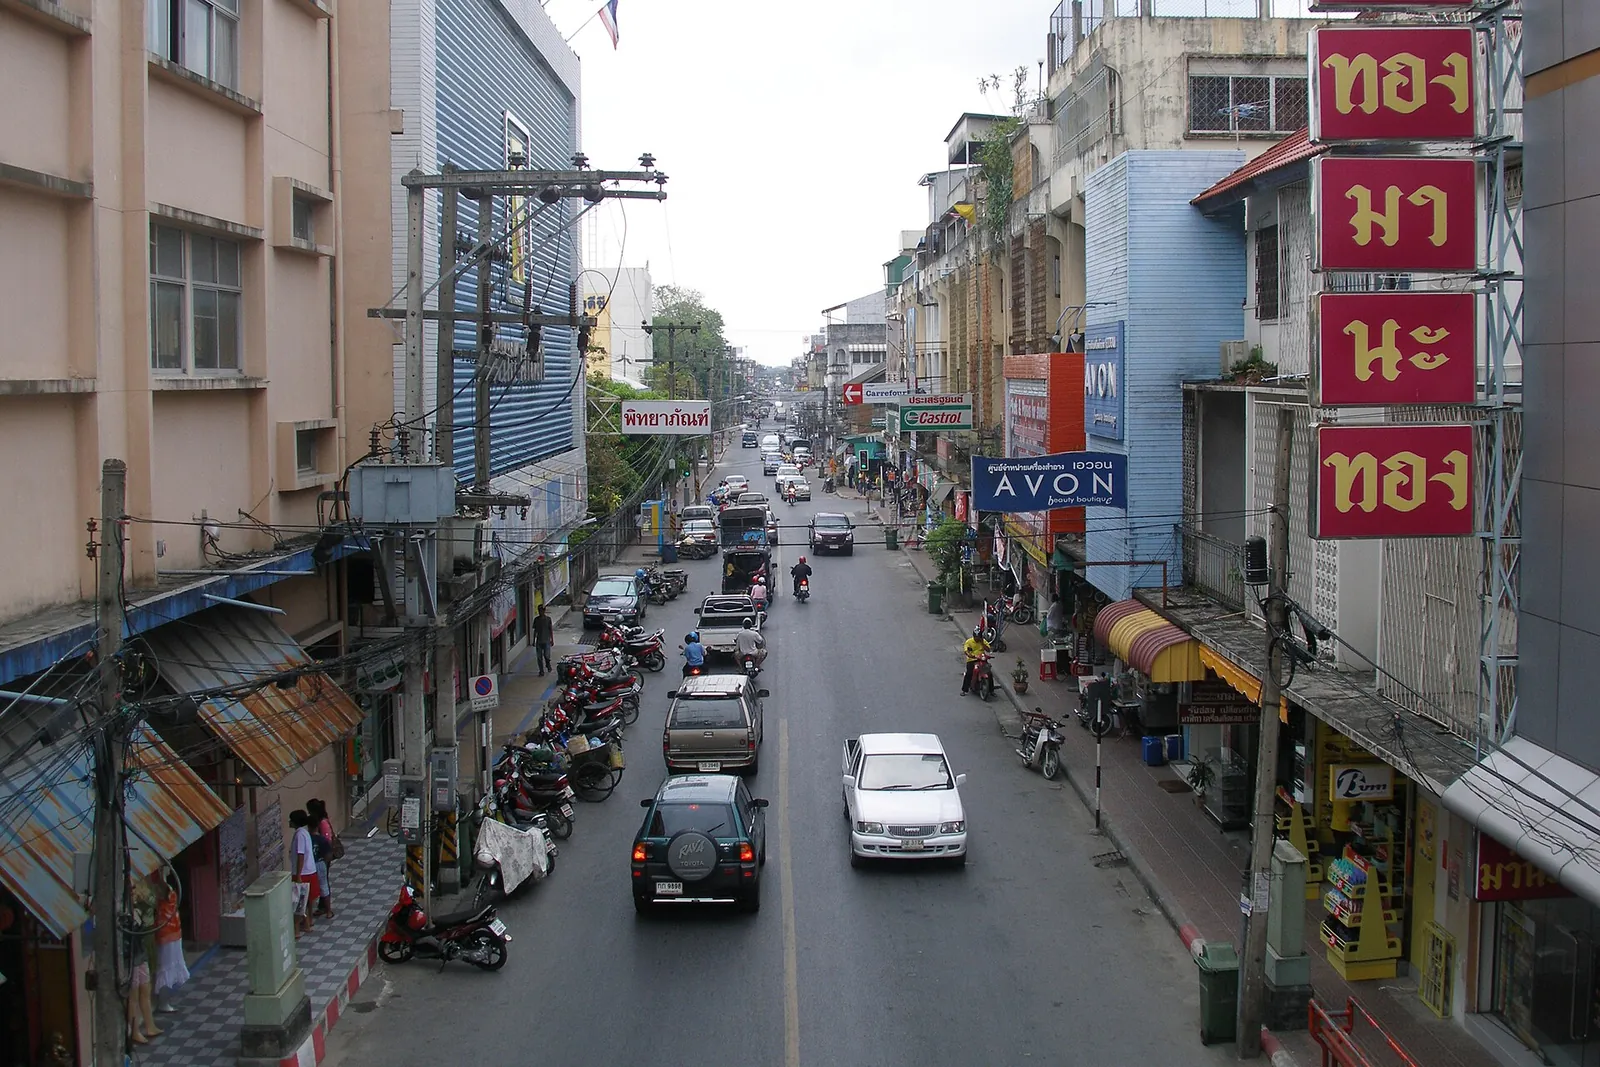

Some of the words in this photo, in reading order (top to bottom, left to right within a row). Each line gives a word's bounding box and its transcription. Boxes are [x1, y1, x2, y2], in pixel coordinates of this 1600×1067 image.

[1322, 52, 1469, 115] ทอง
[1344, 184, 1448, 247] มา
[1342, 318, 1451, 382] นะ
[1085, 361, 1117, 399] AVON
[919, 411, 962, 425] Castrol
[1073, 461, 1113, 470] เอวอน
[1322, 450, 1469, 513] ทอง
[993, 472, 1113, 498] AVON
[1047, 495, 1075, 506] beauty
[1076, 495, 1113, 505] boutique
